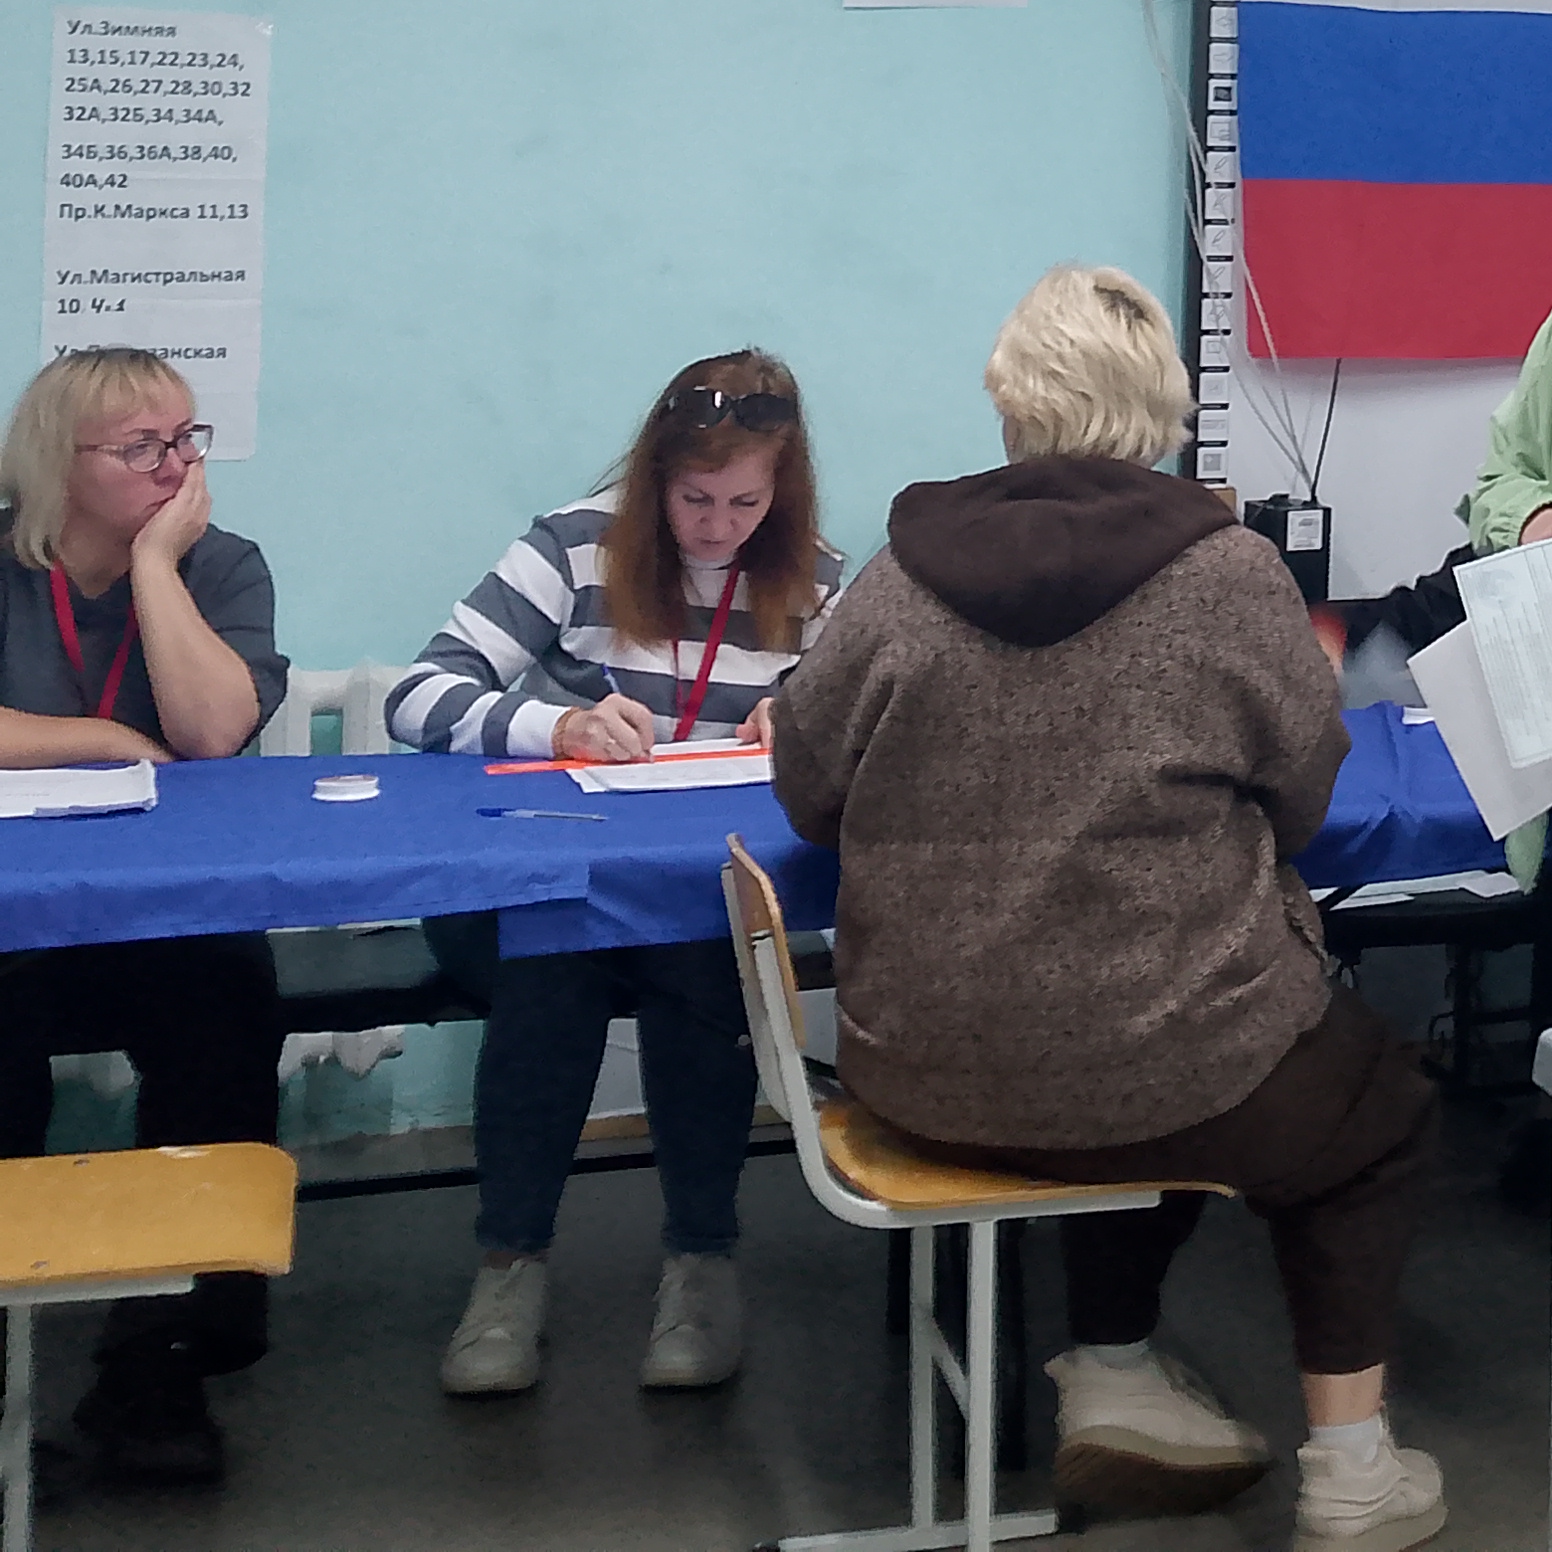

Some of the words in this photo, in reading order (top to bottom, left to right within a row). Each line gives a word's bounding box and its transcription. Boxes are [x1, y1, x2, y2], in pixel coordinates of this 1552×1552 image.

[66, 19, 178, 38] Ул.Зимняя
[66, 48, 245, 71] 13,15,17,22,23,24,
[58, 203, 191, 223] Пр.К.Маркса
[196, 204, 250, 222] 11,13
[56, 268, 246, 287] Ул.Магистральная
